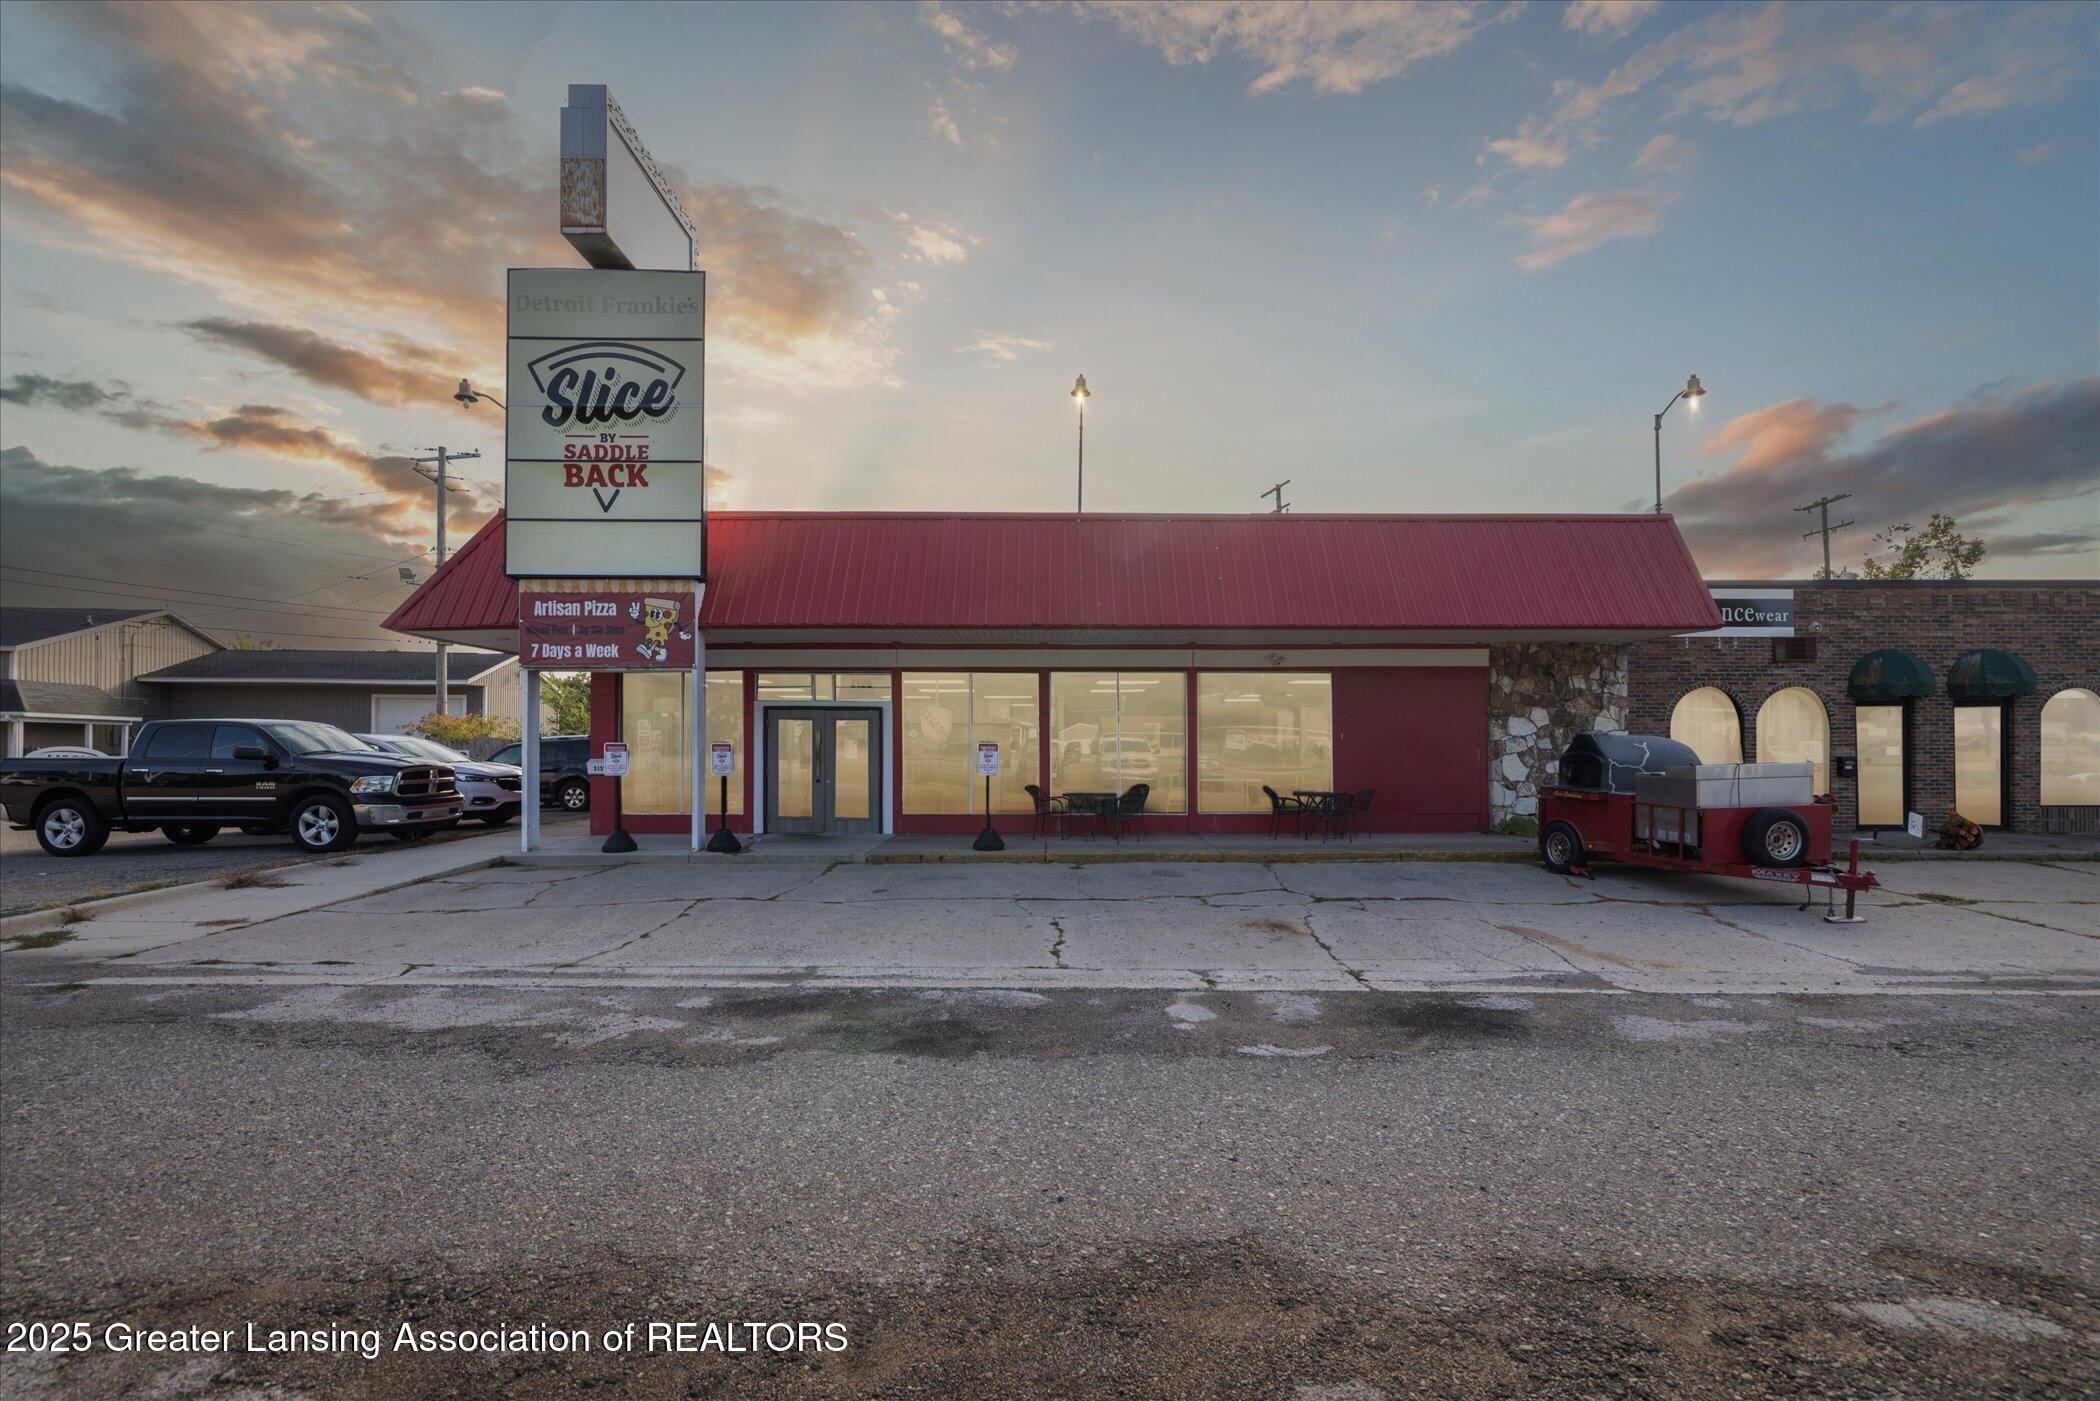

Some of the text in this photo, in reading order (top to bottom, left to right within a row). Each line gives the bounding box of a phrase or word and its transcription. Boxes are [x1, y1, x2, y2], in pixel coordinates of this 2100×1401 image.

[516, 294, 699, 315] Detroit Frankie's
[541, 366, 676, 428] Slice
[600, 433, 616, 443] BY
[564, 443, 649, 460] SADDLE
[564, 463, 649, 487] BACK
[534, 600, 617, 616] Artisan Pizza
[531, 643, 619, 660] 7 Days a Week
